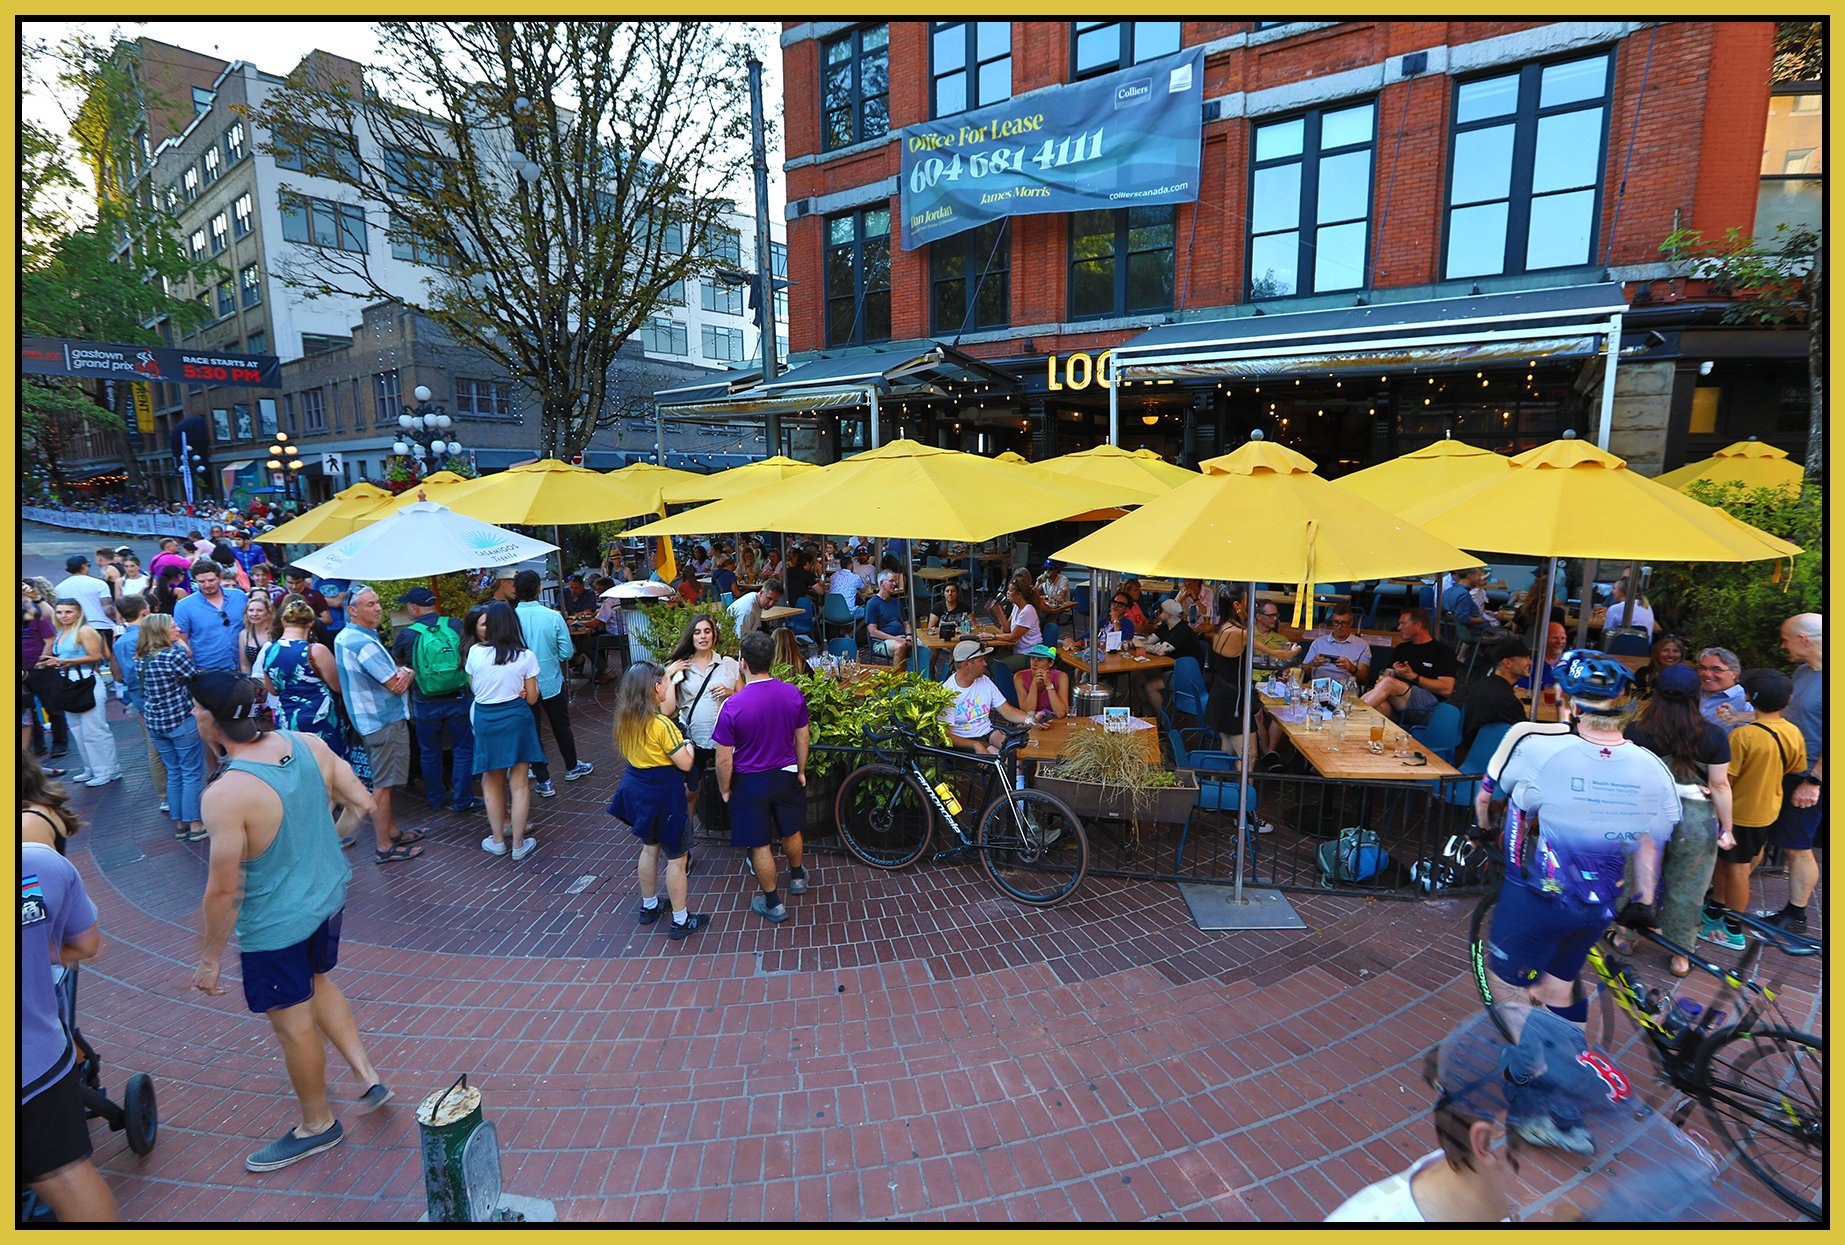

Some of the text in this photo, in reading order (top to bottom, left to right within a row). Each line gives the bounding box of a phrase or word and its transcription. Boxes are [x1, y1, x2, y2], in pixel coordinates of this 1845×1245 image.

[1118, 86, 1148, 99] Colliers
[909, 113, 1044, 153] Office For Lease
[910, 126, 1105, 194] 604 681 4111
[980, 186, 1051, 205] James Morris
[1109, 182, 1188, 200] collierscanada.com
[925, 205, 953, 224] Jordan
[71, 349, 123, 360] gastown
[183, 356, 209, 365] RACE
[210, 358, 245, 367] STARTS
[73, 359, 134, 371] grand prix
[184, 365, 261, 382] 5:30 PM
[914, 770, 961, 834] cannondale
